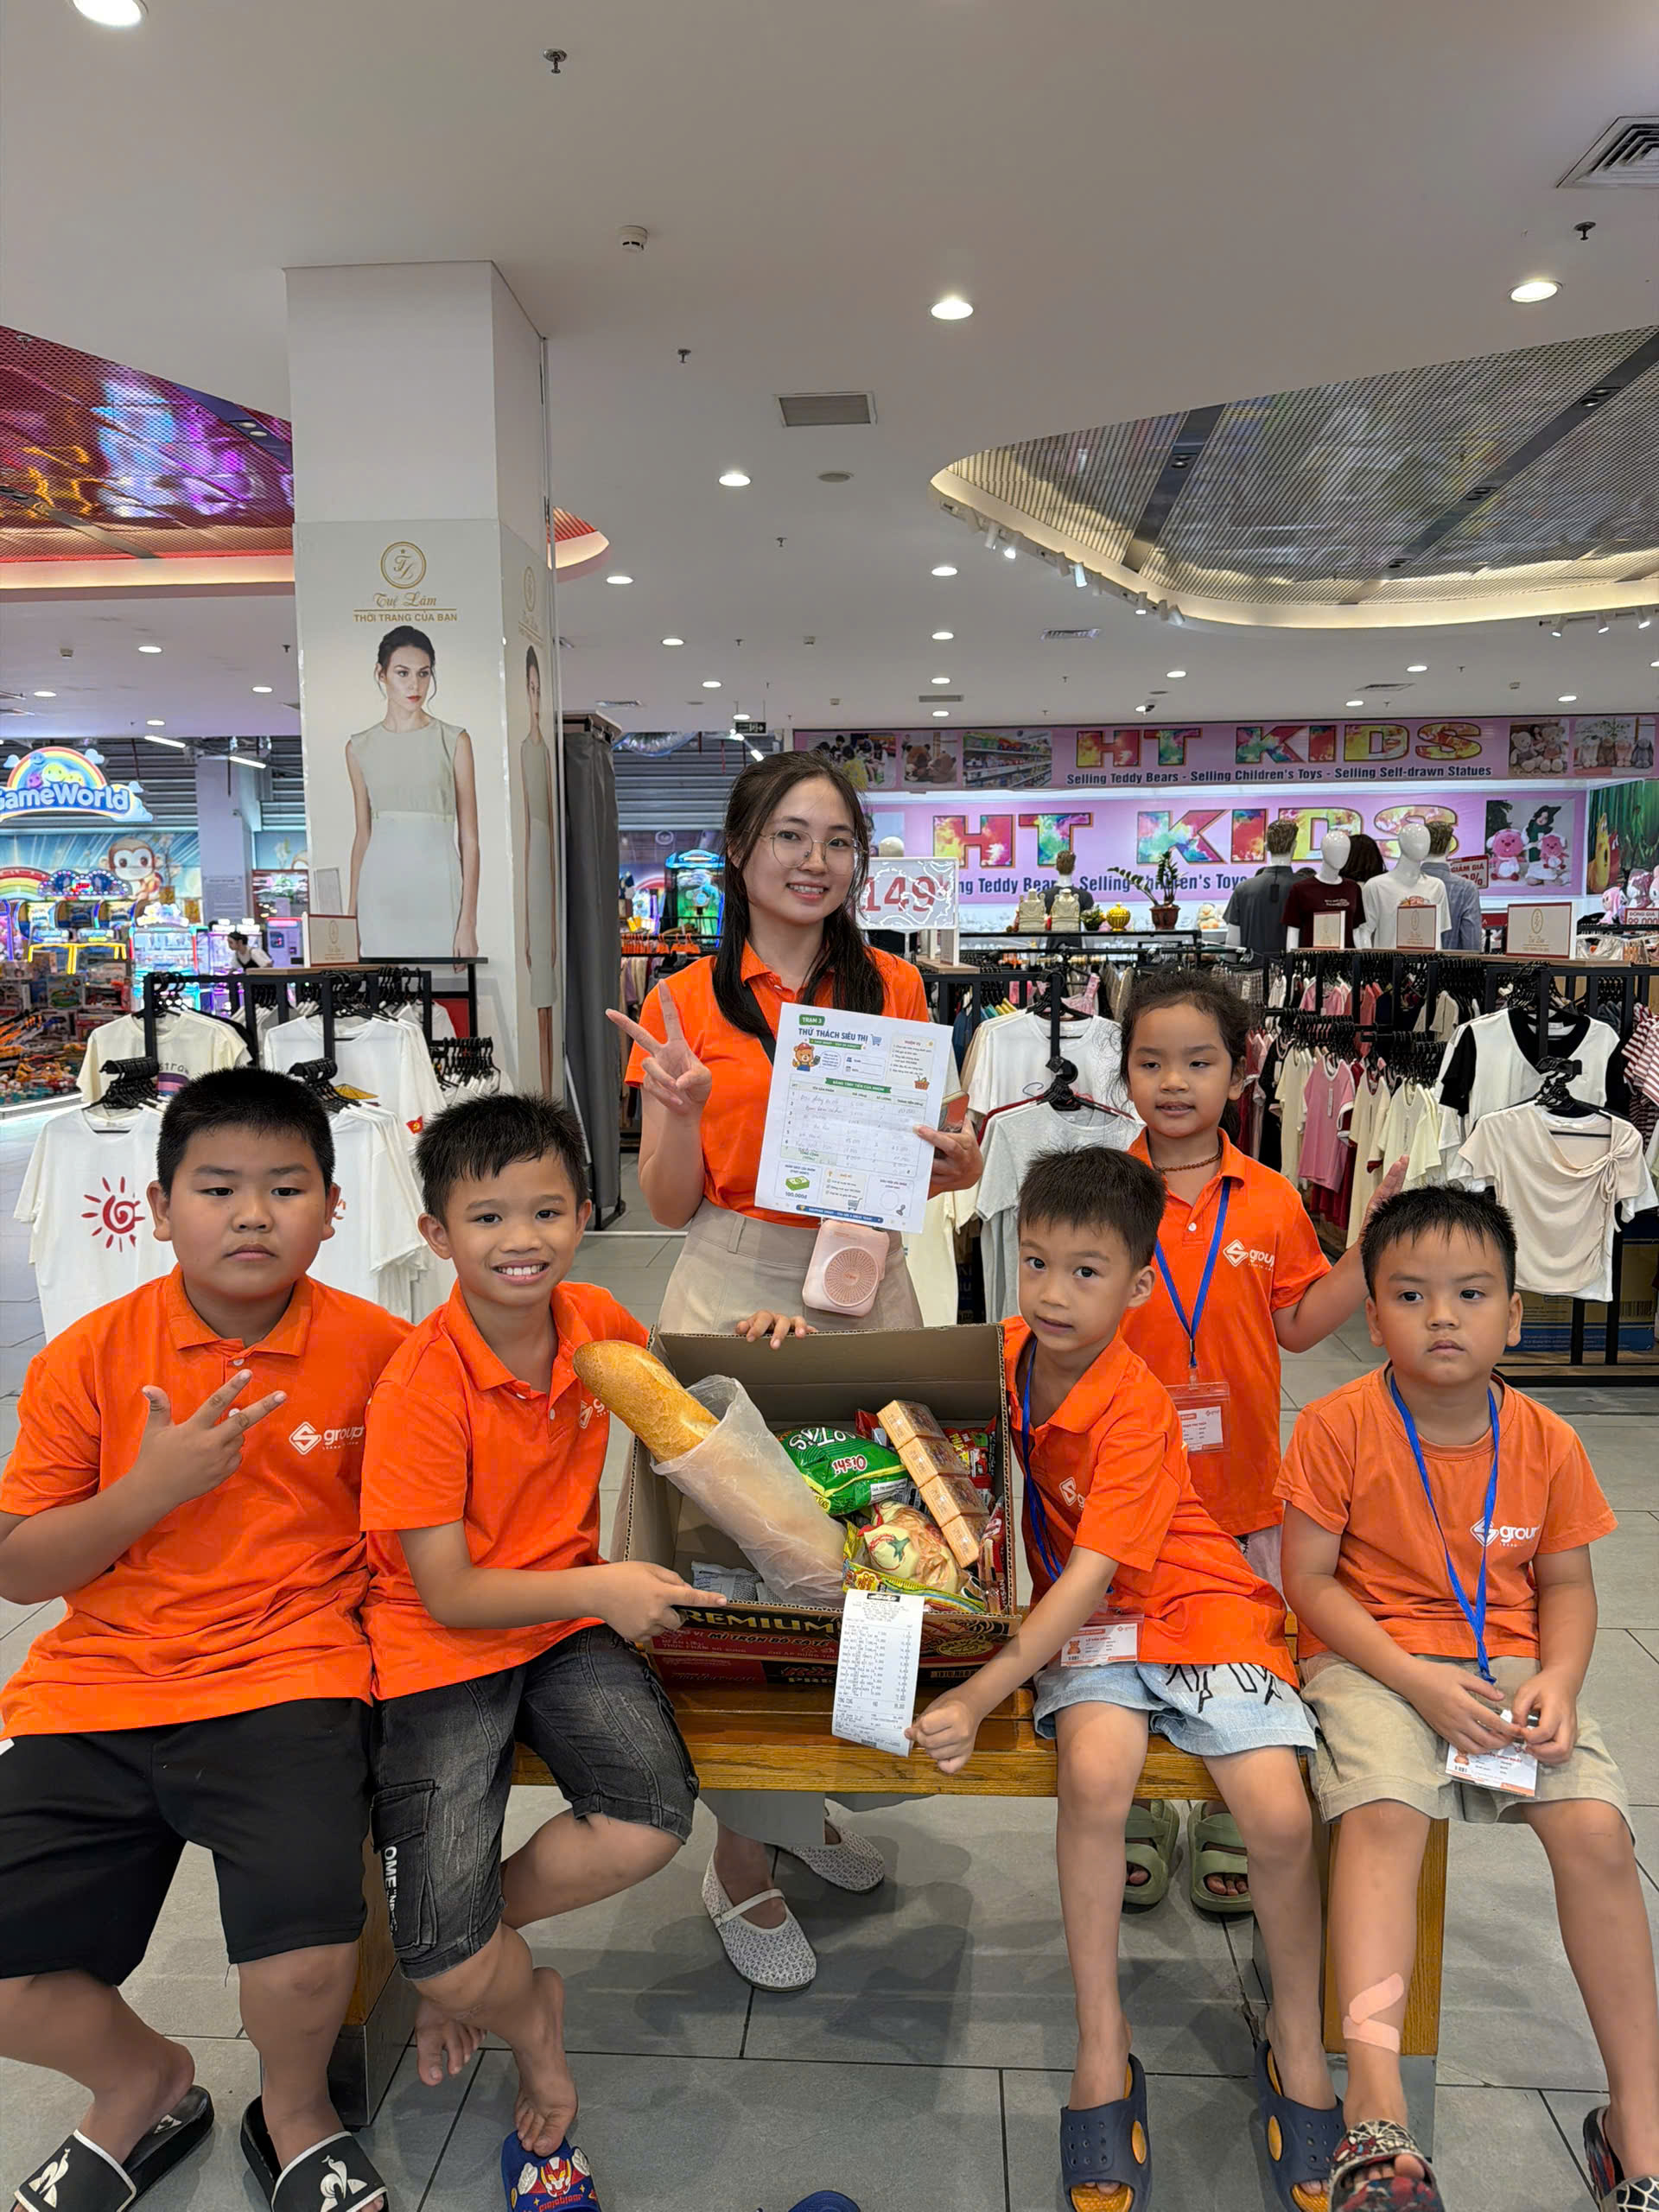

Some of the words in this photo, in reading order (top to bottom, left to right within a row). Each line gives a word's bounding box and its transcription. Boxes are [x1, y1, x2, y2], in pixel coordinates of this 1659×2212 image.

[1077, 728, 1203, 768] HT
[1236, 722, 1483, 766] KIDS
[1066, 773, 1107, 785] Selling
[1110, 773, 1142, 784] Teddy
[1146, 772, 1179, 783] Bears
[1191, 771, 1231, 782] Selling
[1235, 768, 1294, 781] Children's
[1298, 768, 1323, 780] Toys
[1335, 767, 1376, 779] Selling
[1380, 766, 1444, 778] Self-drawn
[1447, 765, 1491, 777] Statues
[933, 812, 1094, 869] HT
[978, 877, 1018, 894] Teddy
[1023, 877, 1057, 893] Bear
[1080, 875, 1131, 893] Selling
[817, 1028, 840, 1039] THÁCH
[832, 1453, 868, 1474] Oishi
[1500, 1524, 1541, 1543] grou
[683, 1608, 835, 1634] REMIUM
